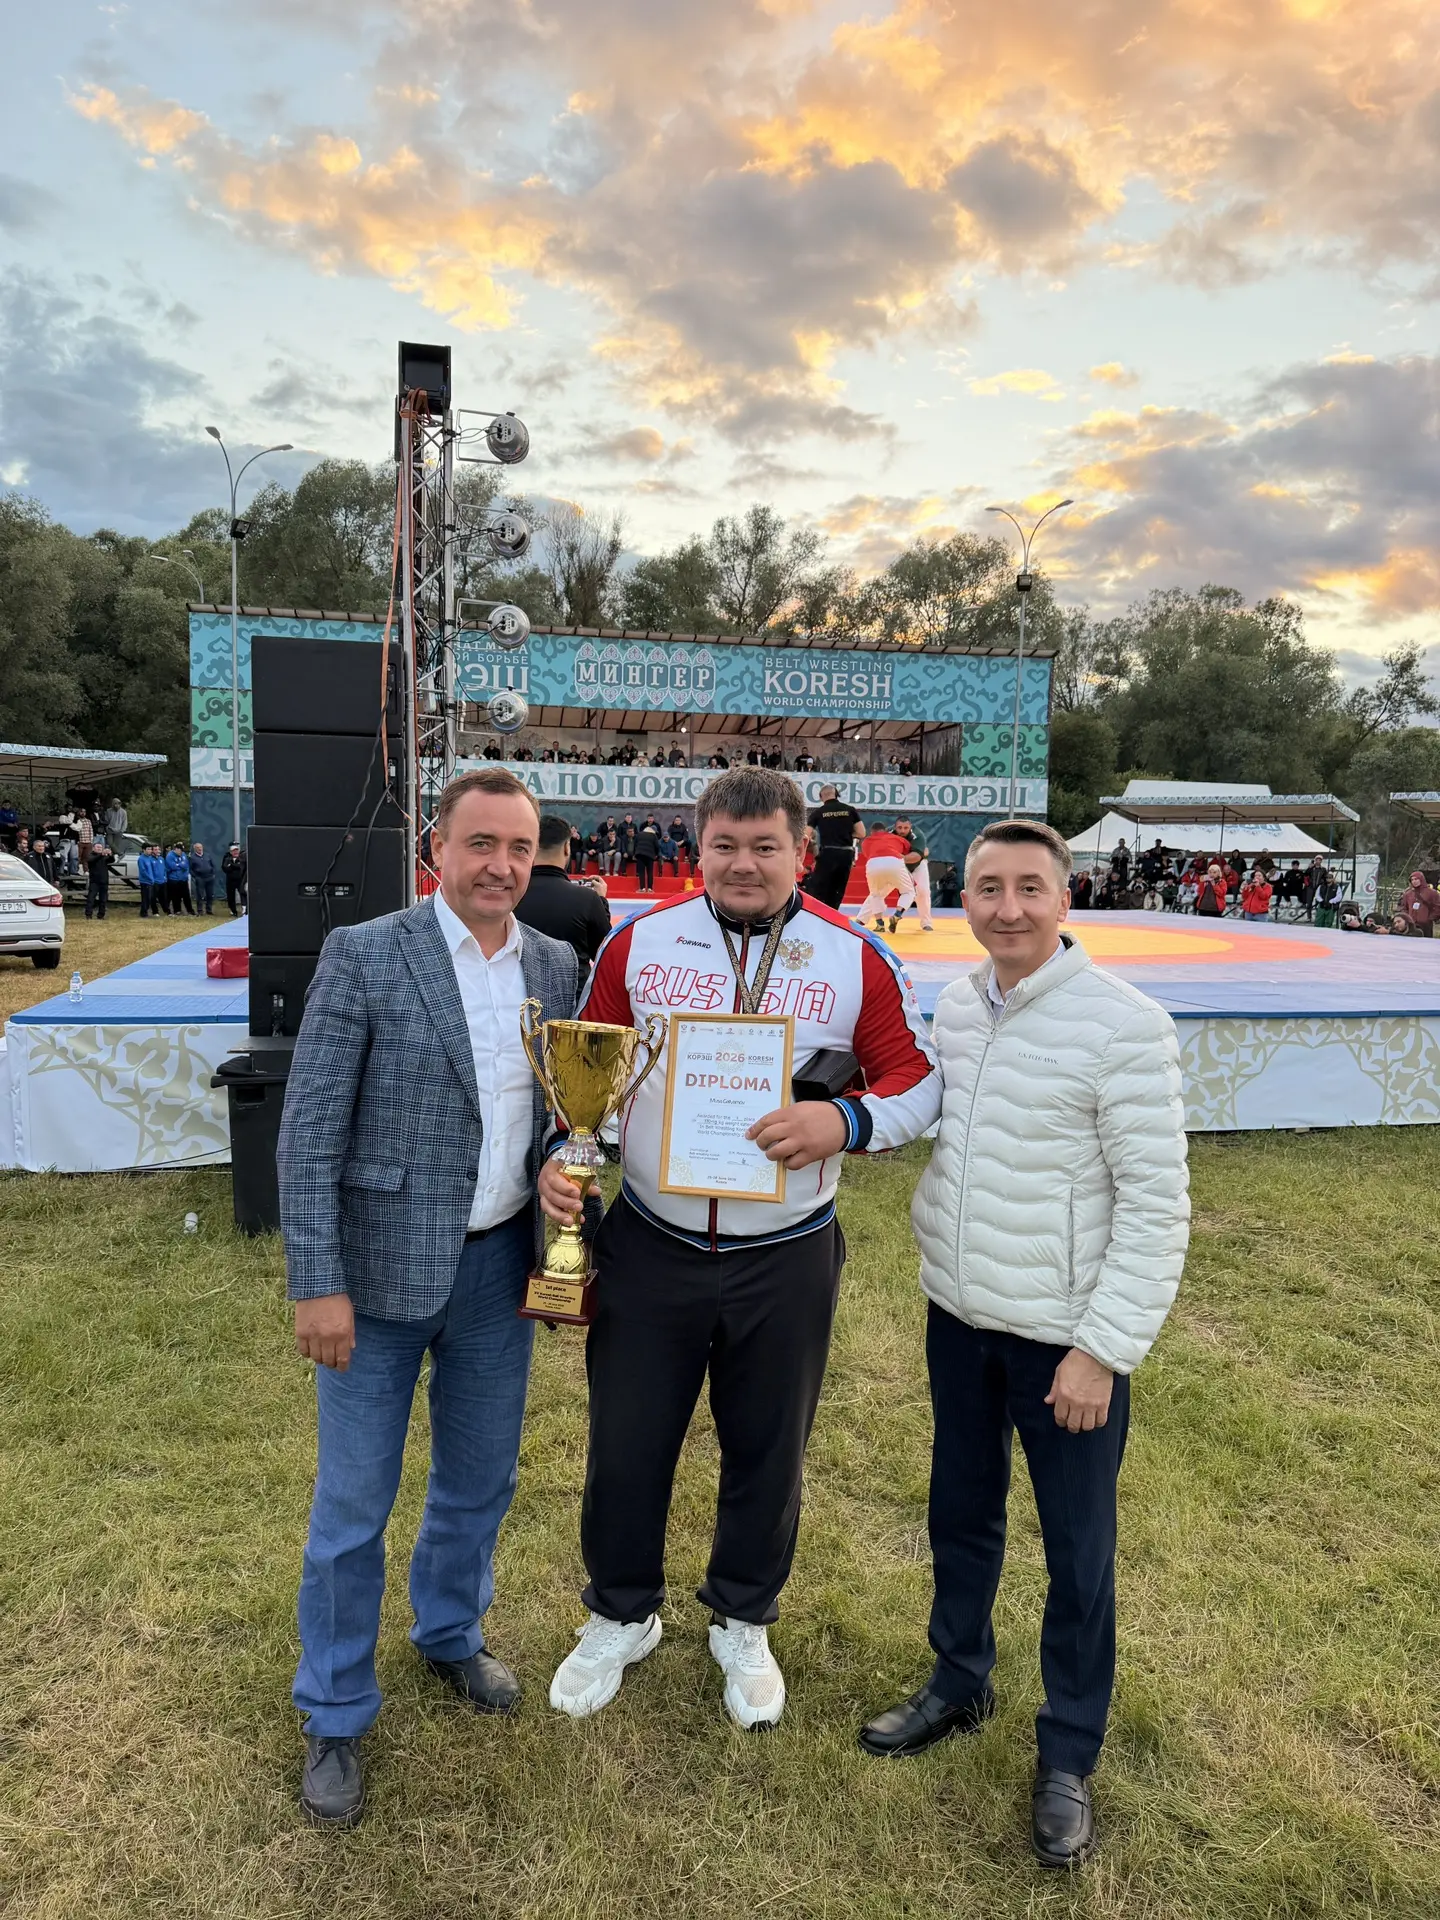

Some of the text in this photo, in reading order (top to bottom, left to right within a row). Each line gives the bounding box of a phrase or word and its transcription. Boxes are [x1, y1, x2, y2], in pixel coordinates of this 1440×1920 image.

[477, 653, 529, 665] БОРЬБЕ
[765, 657, 893, 673] BELT WRESTLING
[577, 662, 711, 689] МИНГЕР
[763, 670, 892, 698] KORESH
[763, 696, 892, 710] WORLD CHAMPIONSHIP
[558, 772, 604, 797] ПО
[635, 963, 836, 1024] RUSSIA
[715, 1052, 745, 1063] 2026
[685, 1073, 772, 1092] DIPLOMA
